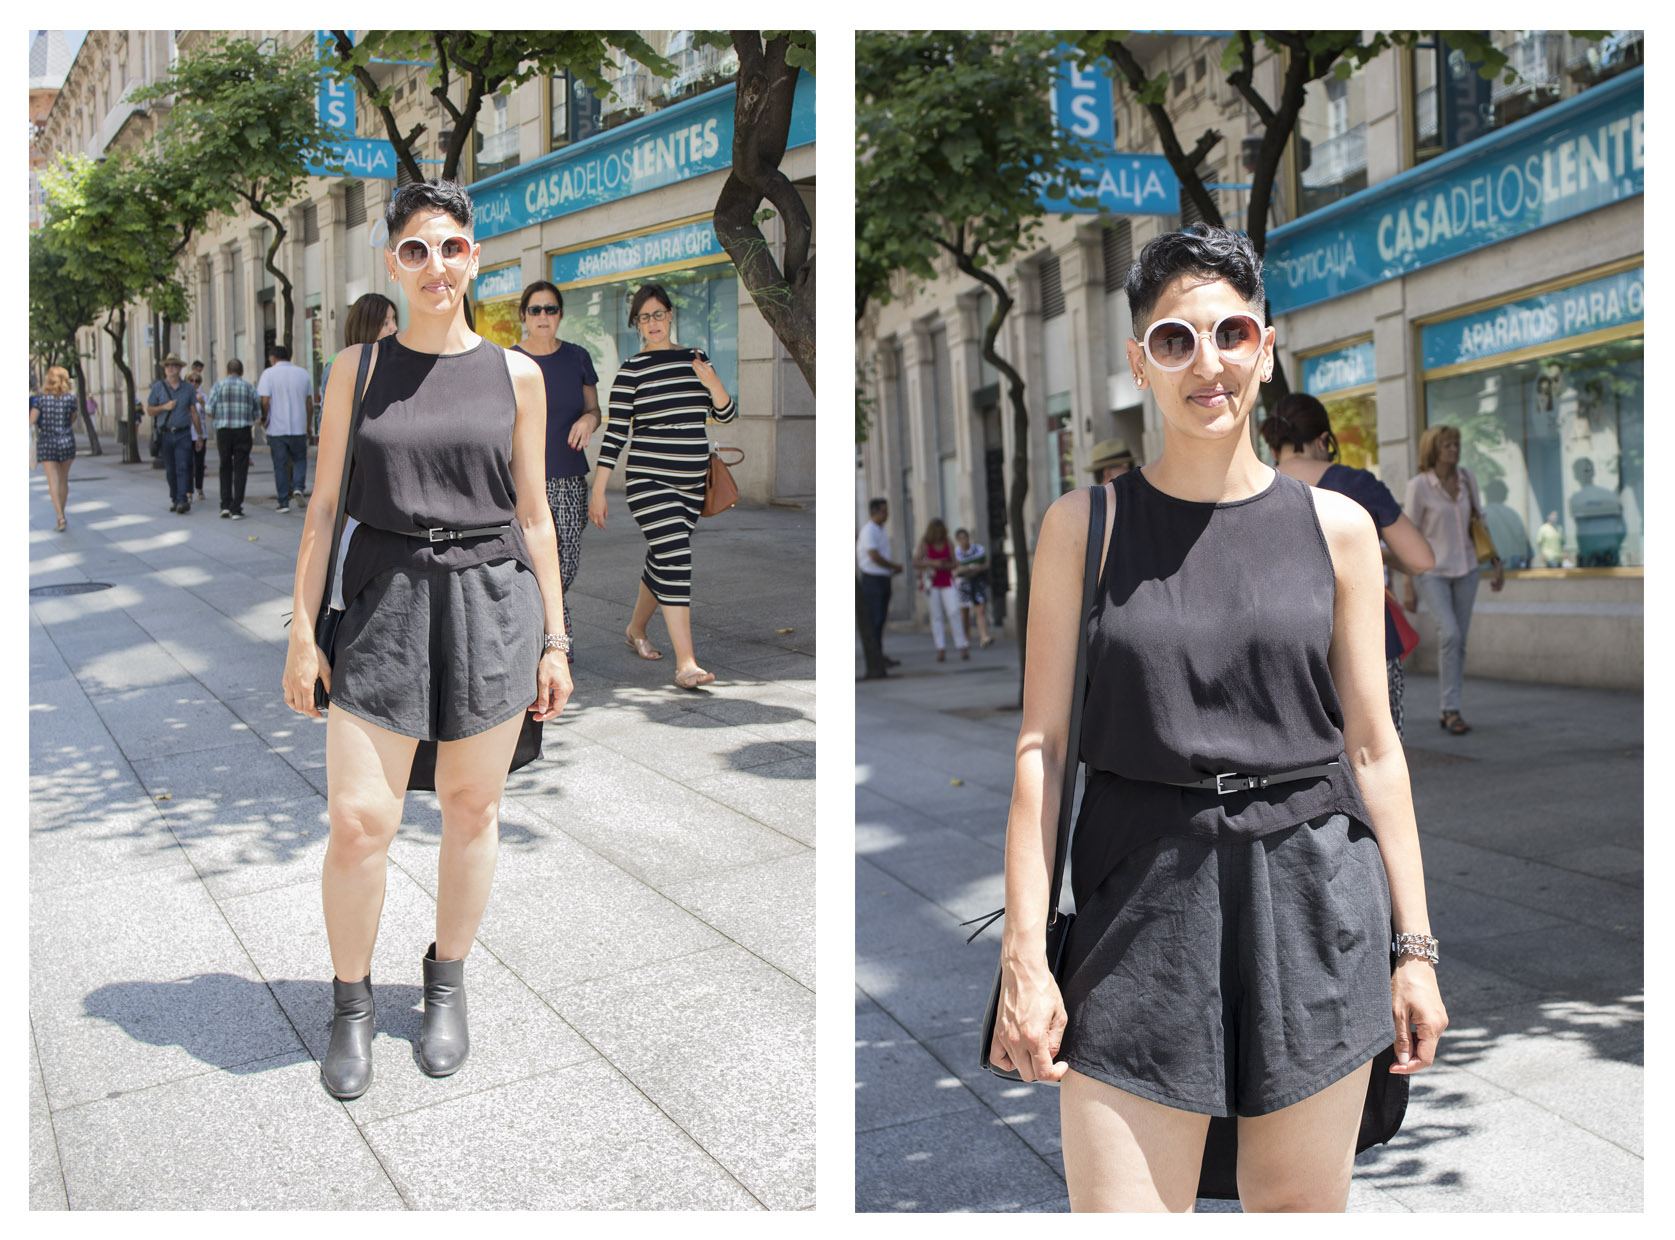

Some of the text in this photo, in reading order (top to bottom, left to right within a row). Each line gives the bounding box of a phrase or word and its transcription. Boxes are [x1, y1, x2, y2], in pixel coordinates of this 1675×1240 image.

[577, 246, 641, 275] APARATOS
[645, 237, 681, 263] PARA
[1462, 306, 1558, 354] APARATOS
[1563, 289, 1621, 330] PARA
